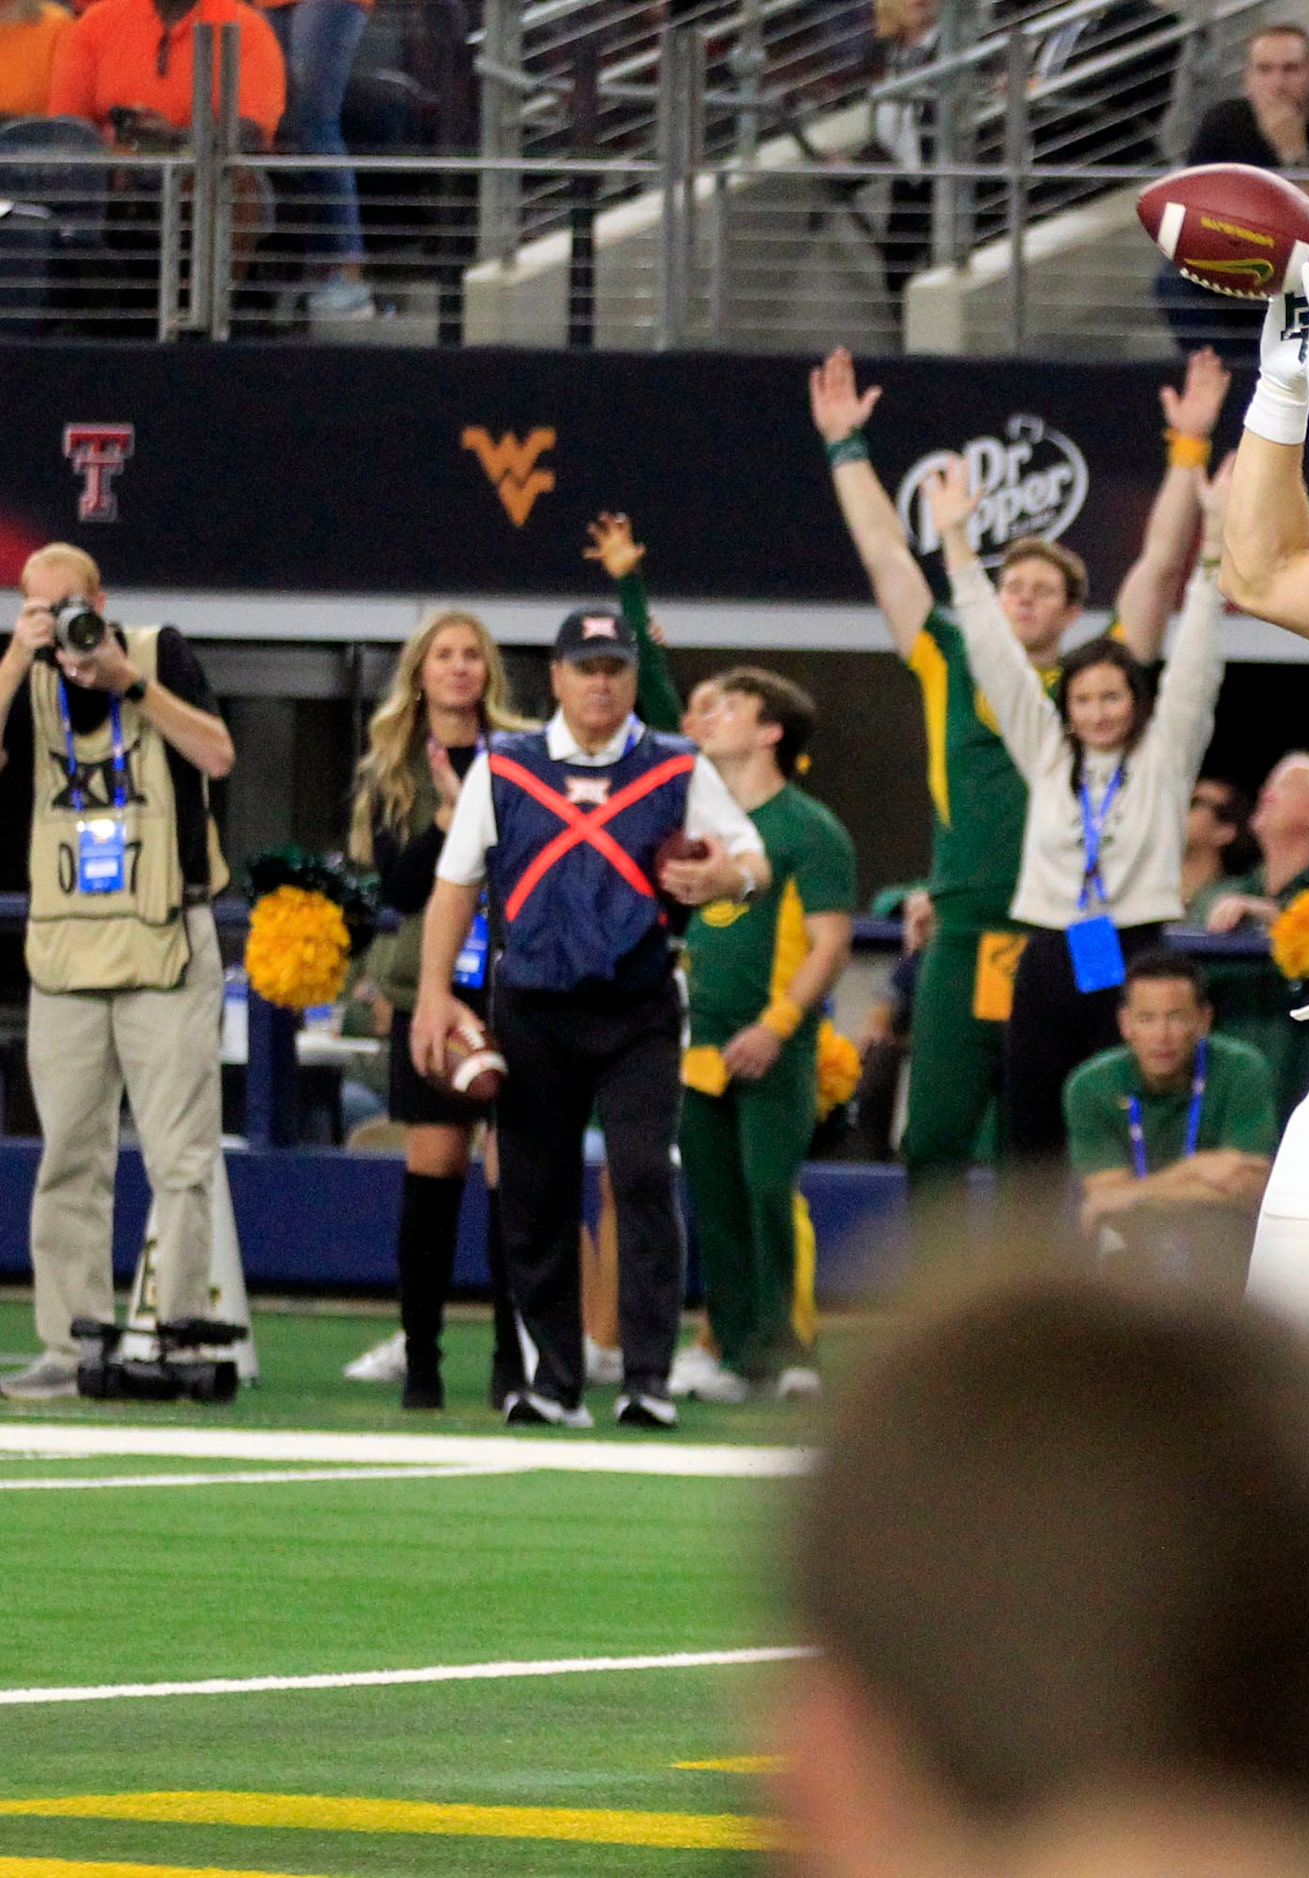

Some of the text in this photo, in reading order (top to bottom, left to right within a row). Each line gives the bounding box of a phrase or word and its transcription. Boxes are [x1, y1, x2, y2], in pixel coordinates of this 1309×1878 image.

[964, 436, 1033, 497] Dr
[918, 463, 1072, 556] Ppper
[58, 841, 143, 895] 07
